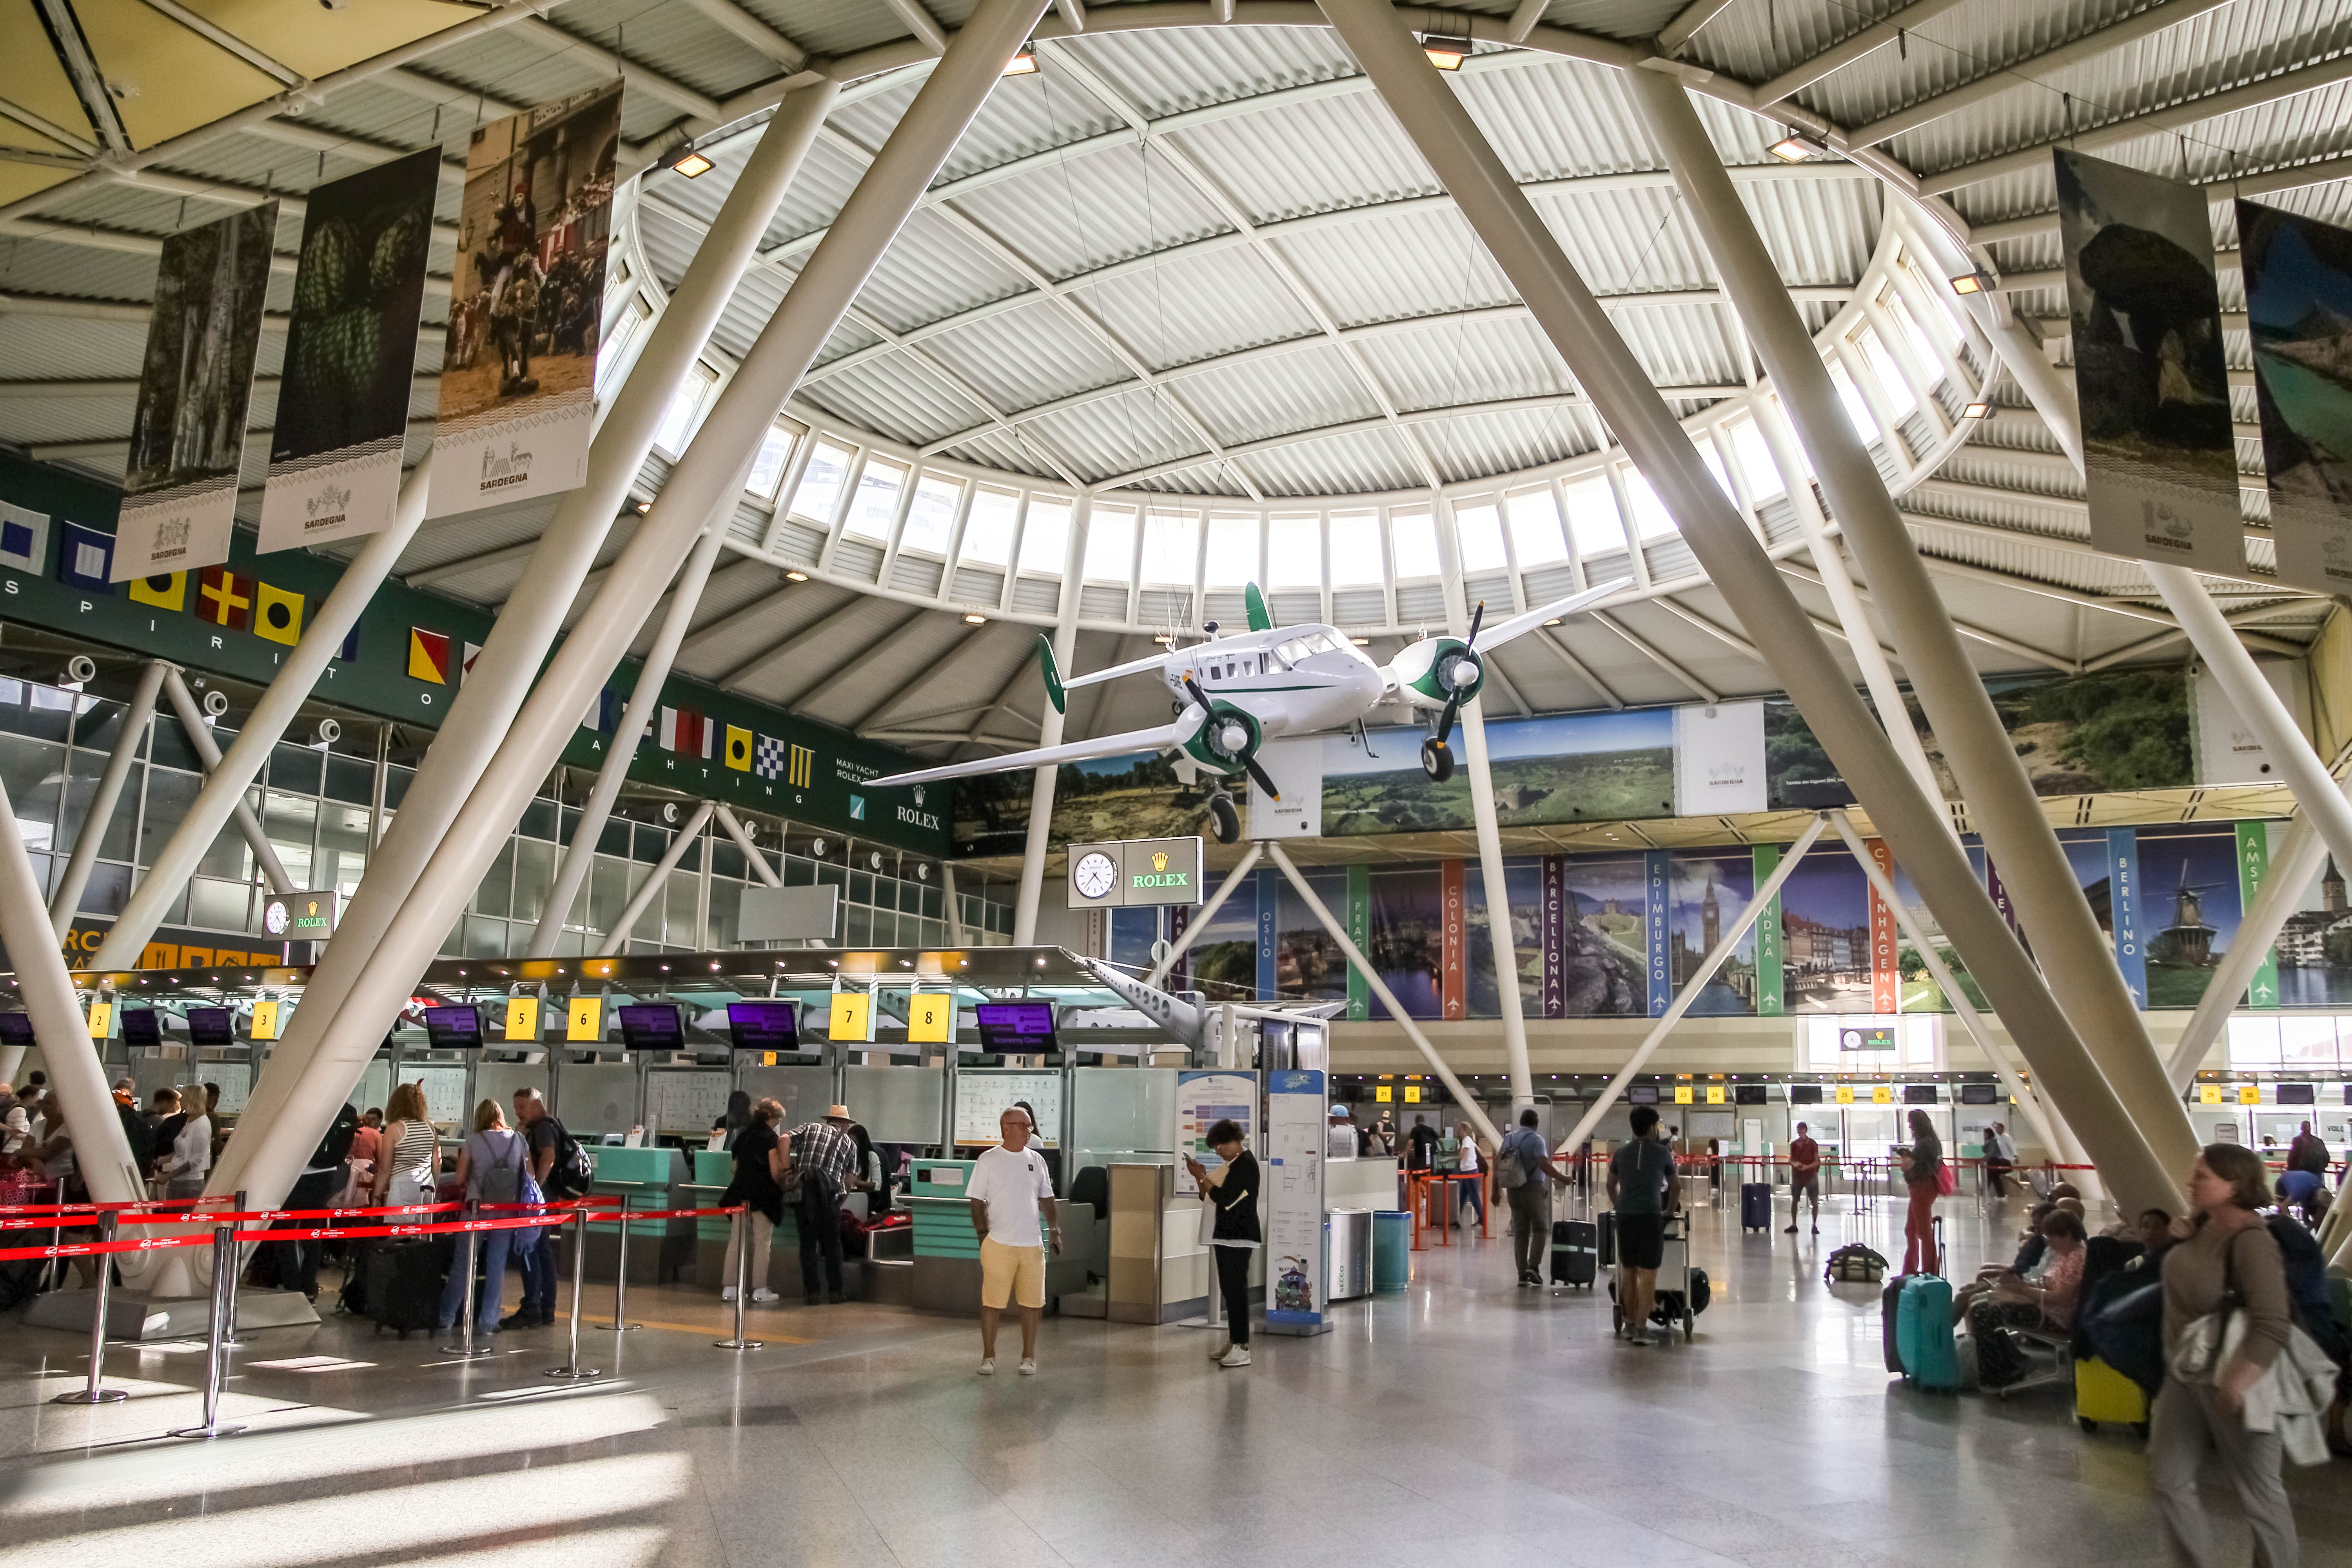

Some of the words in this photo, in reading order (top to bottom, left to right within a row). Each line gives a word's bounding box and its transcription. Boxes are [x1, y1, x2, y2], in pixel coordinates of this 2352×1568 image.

[480, 473, 528, 490] SARDEGNA
[304, 514, 345, 529] SARDEGNA
[2145, 534, 2192, 551] SARDEGNA
[151, 547, 186, 560] SARDEGNA
[2325, 567, 2352, 579] SARDE
[837, 758, 853, 770] MAXI
[855, 764, 879, 778] YACHT
[837, 769, 861, 784] ROLEX
[897, 806, 940, 830] ROLEX
[1132, 873, 1188, 888] ROLEX
[2119, 857, 2135, 956] BERLINO
[298, 918, 327, 928] ROLEX
[1353, 901, 1363, 949] PRAG
[1448, 886, 1458, 972] COLONIA
[1549, 862, 1559, 989] BARCELLONA
[1652, 864, 1664, 981] EDIMBURGO
[1262, 912, 1271, 958] OSLO
[97, 1016, 102, 1025] 2
[262, 1015, 267, 1025] 3
[518, 1013, 524, 1024] 5
[581, 1014, 587, 1025] 6
[846, 1011, 853, 1024] 7
[925, 1011, 932, 1025] 8
